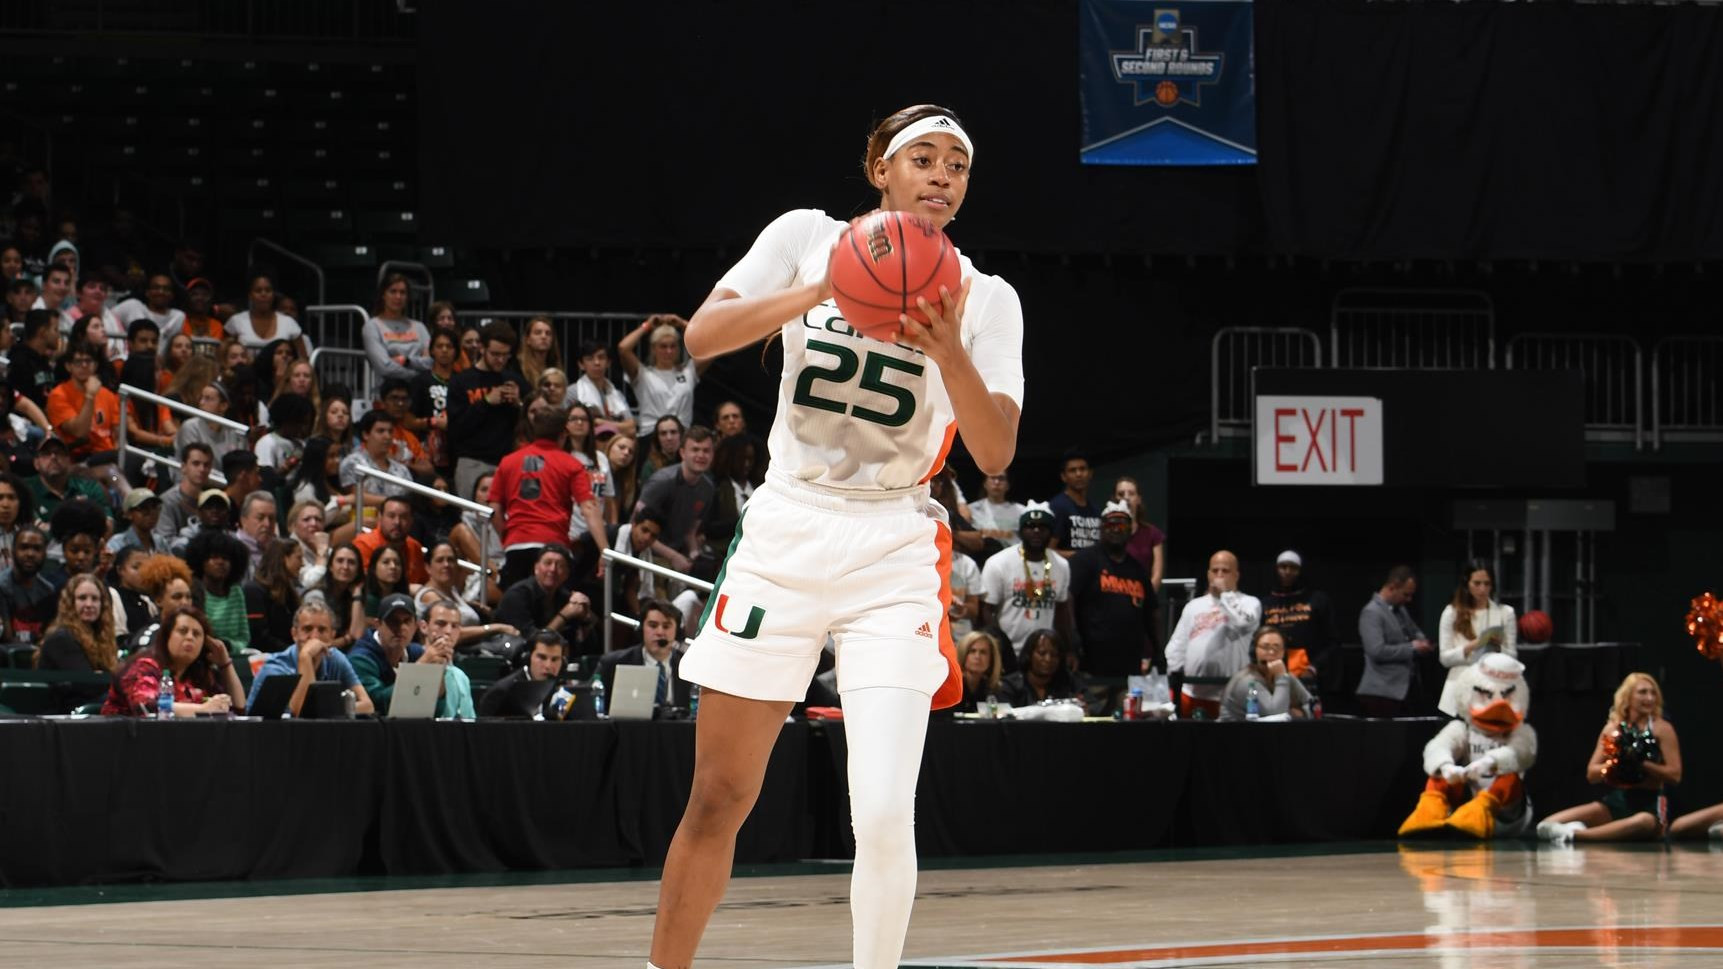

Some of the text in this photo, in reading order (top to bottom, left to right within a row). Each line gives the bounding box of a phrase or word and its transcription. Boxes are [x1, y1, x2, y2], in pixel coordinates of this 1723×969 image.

[1121, 61, 1214, 75] SECOND ROUNDS
[1145, 48, 1180, 62] FIRST
[793, 339, 924, 427] 25
[1274, 408, 1364, 473] EXIT
[1069, 515, 1101, 528] TOMM
[715, 594, 766, 640] U
